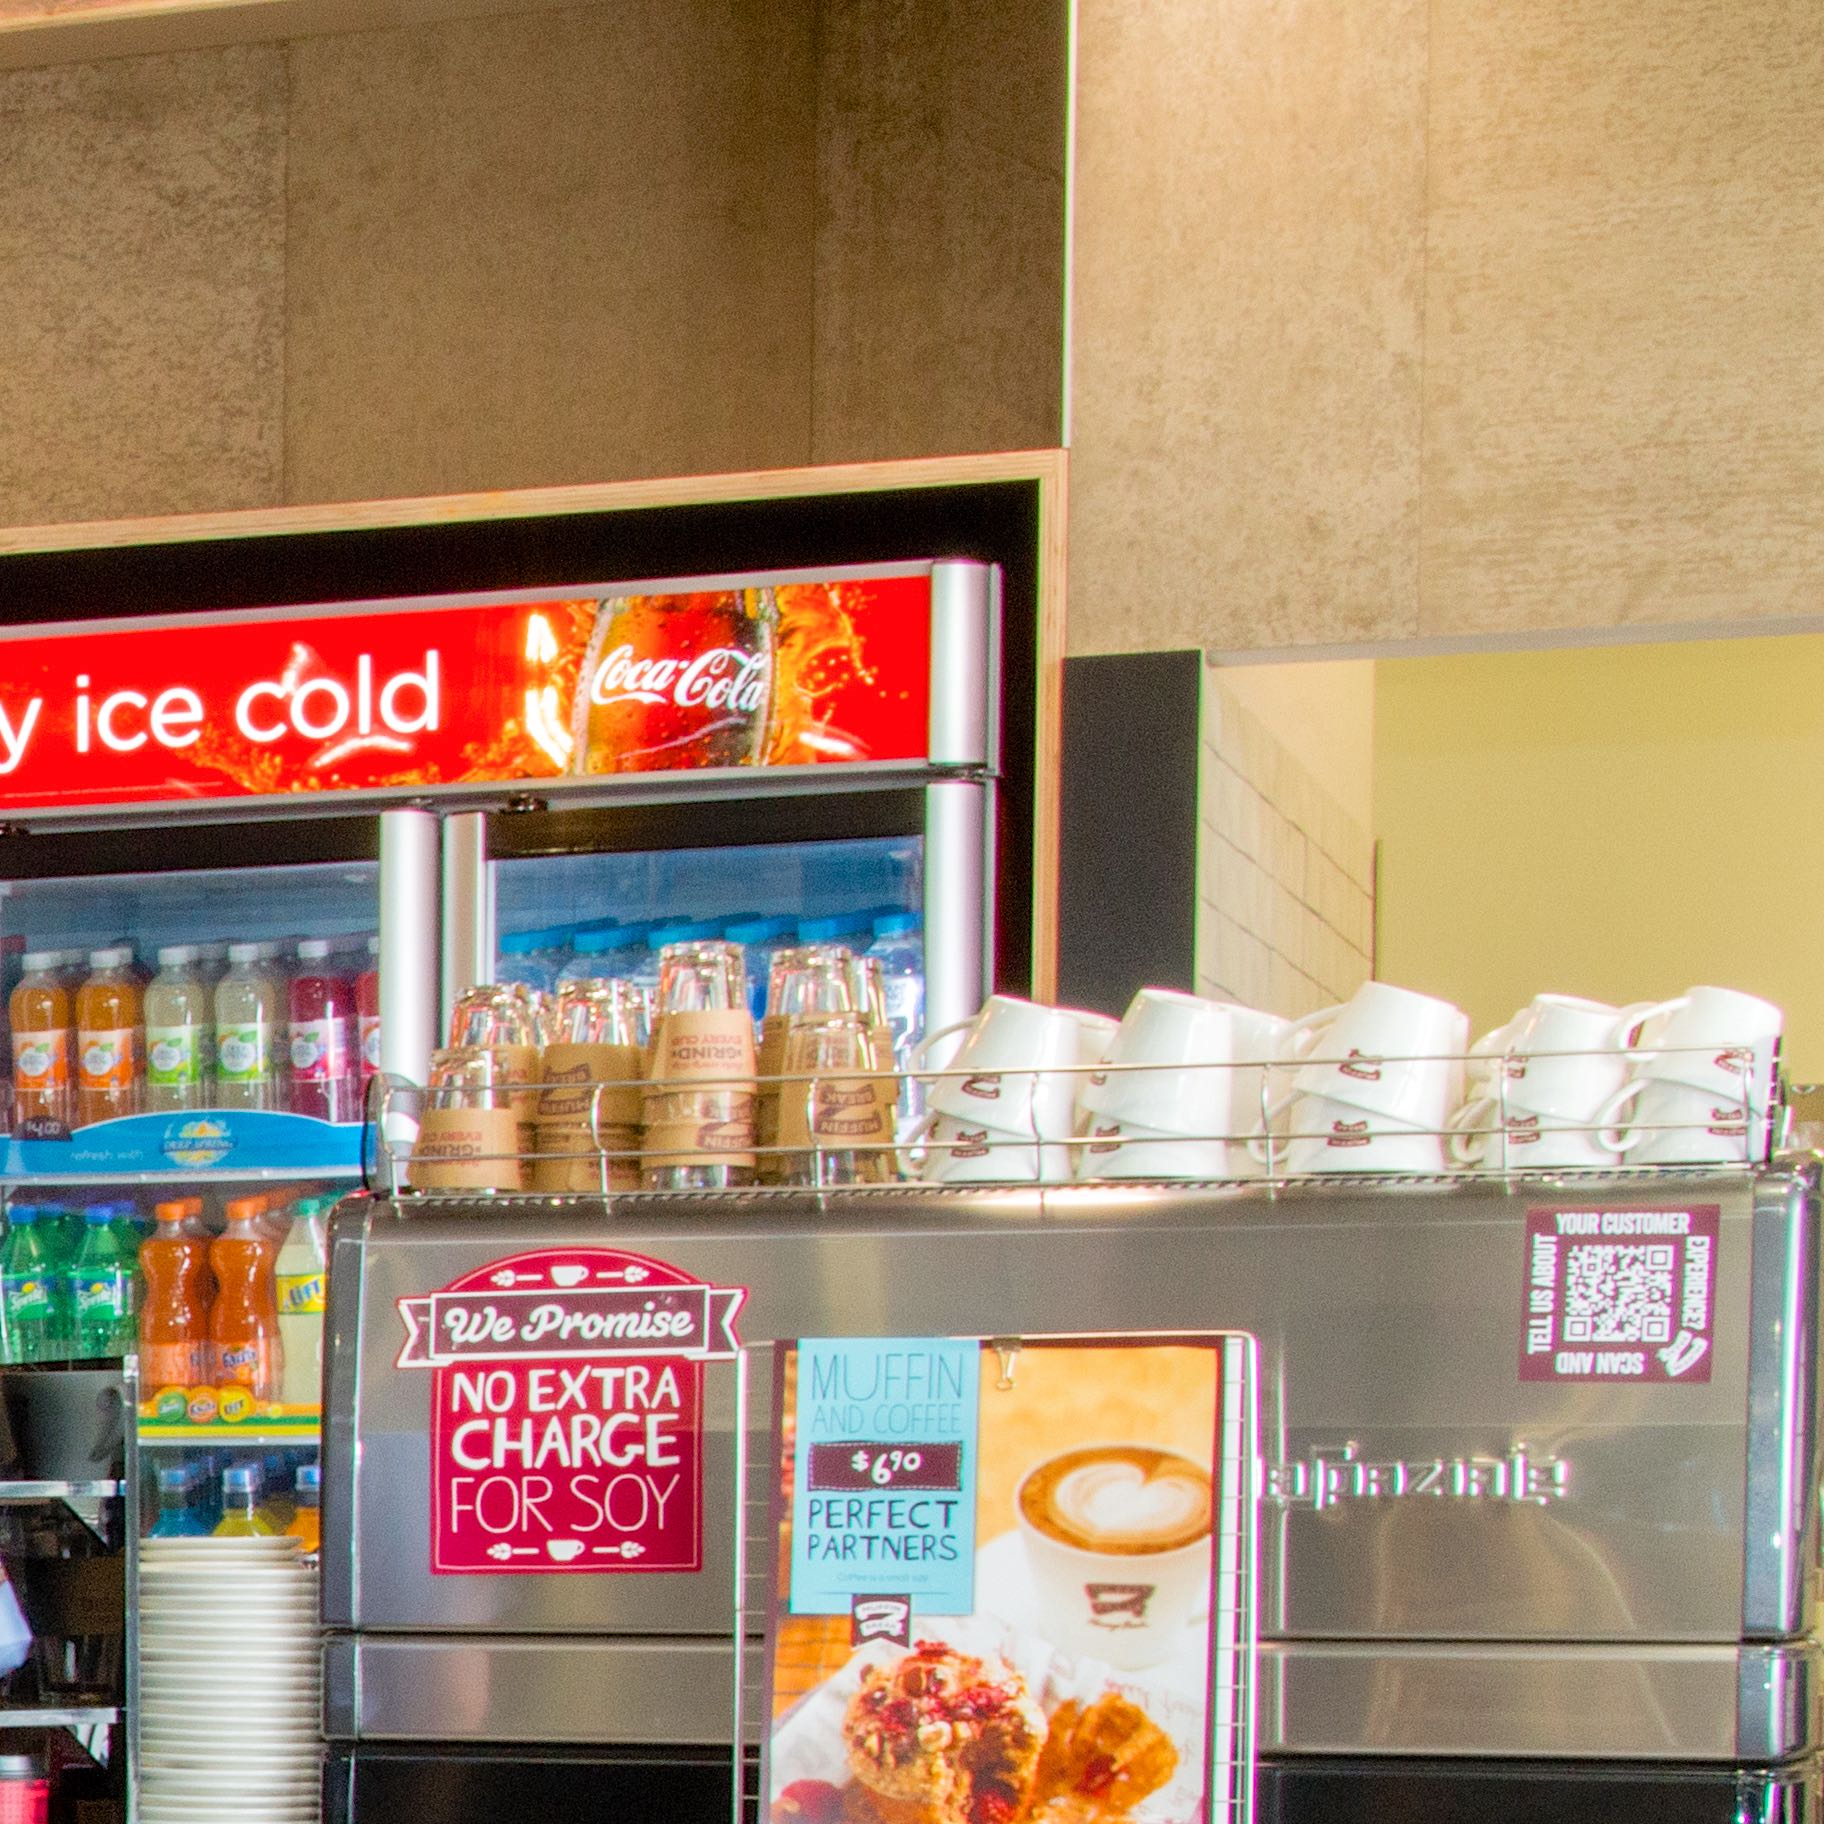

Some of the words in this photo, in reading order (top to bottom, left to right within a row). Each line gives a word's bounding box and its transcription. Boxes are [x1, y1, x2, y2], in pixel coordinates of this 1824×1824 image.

[591, 645, 768, 712] Coca-Cola
[75, 674, 204, 752] ice
[236, 647, 439, 742] cold
[1556, 1214, 1598, 1235] YOUR
[1602, 1213, 1690, 1234] CUSTOMER
[1531, 1233, 1558, 1287] ABOUT
[1529, 1288, 1554, 1313] US
[1682, 1236, 1709, 1330] EXPERIENCE?
[444, 1306, 515, 1343] We
[521, 1302, 695, 1341] Promise
[1527, 1317, 1552, 1354] TELL
[812, 1353, 963, 1400] MUFFIN
[1556, 1353, 1592, 1374] AND
[1596, 1353, 1644, 1374] SCAN
[452, 1370, 515, 1412] NO
[529, 1365, 679, 1411] EXTRA
[812, 1405, 864, 1433] AND
[874, 1404, 961, 1434] COFFEE
[452, 1414, 679, 1470] CHARGE
[452, 1475, 553, 1533] FOR
[570, 1473, 679, 1532] SOY
[808, 1499, 958, 1529] PERFECT
[808, 1534, 957, 1560] PARTNERS
